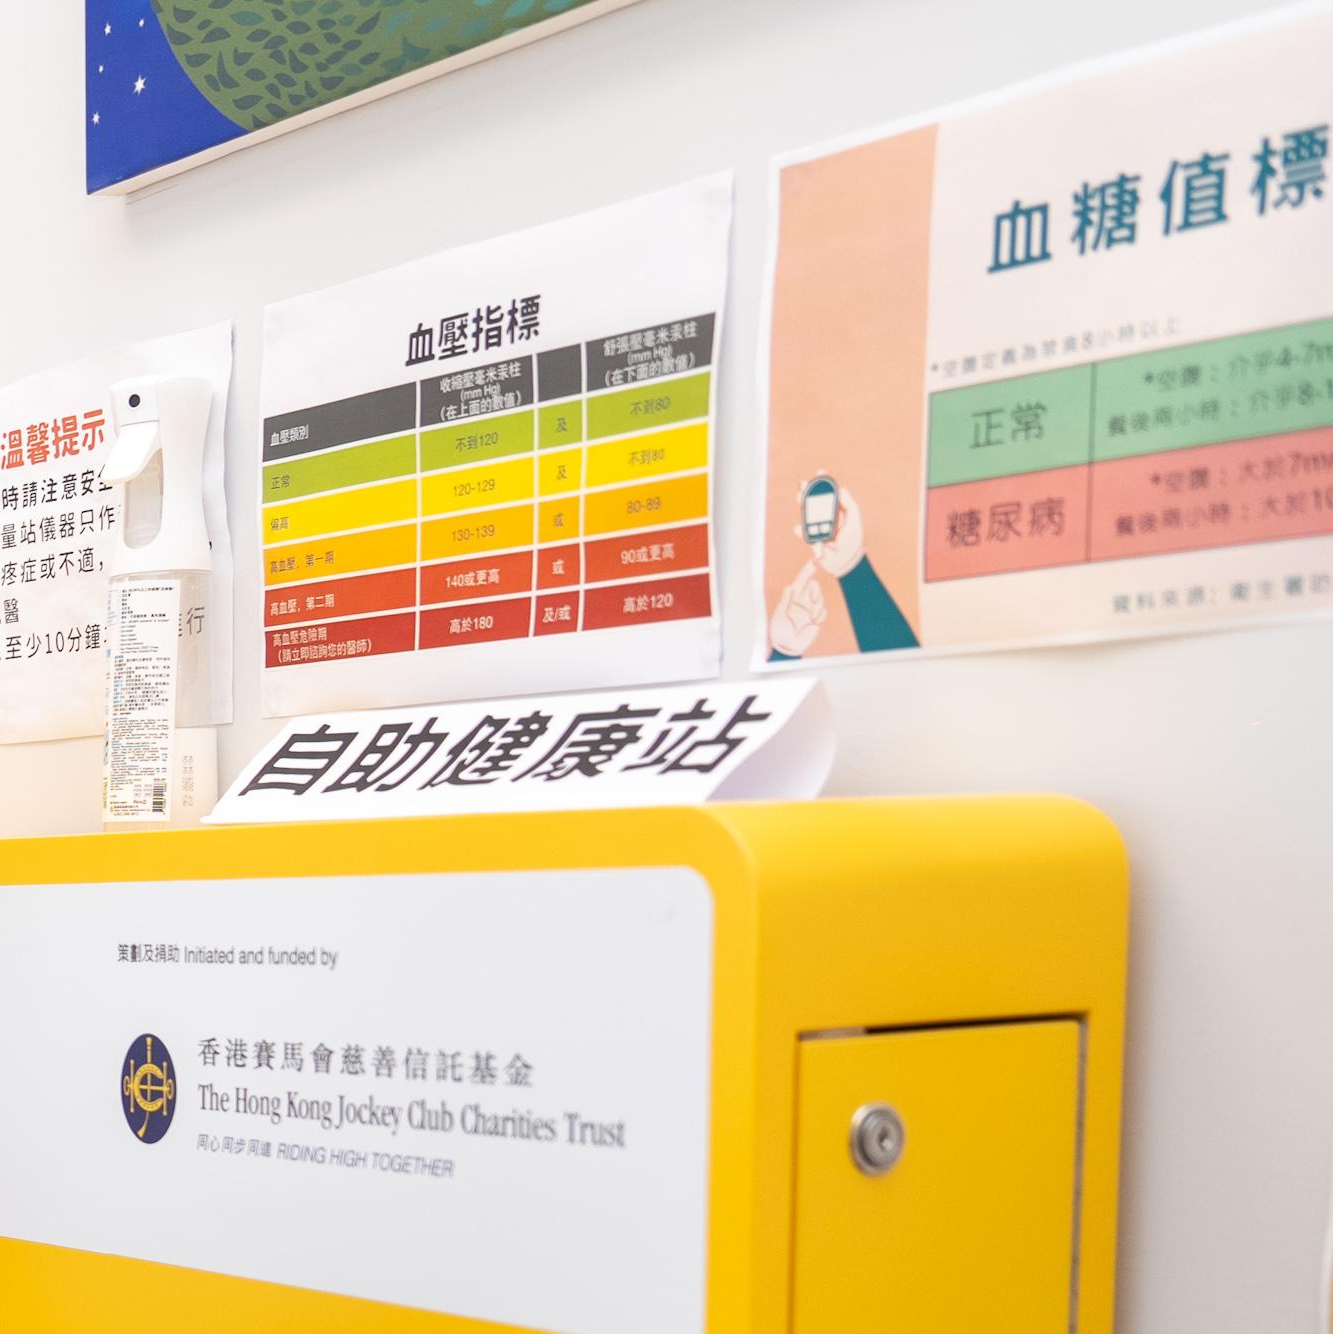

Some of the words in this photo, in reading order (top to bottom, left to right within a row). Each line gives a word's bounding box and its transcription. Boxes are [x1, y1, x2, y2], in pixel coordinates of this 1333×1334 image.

[405, 294, 541, 366] 血壓指標
[556, 417, 568, 432] 及
[969, 400, 1047, 449] 正常
[0, 408, 106, 470] 溫馨提示
[270, 424, 309, 447] 血壓類別
[455, 432, 499, 452] 不到120
[271, 474, 291, 490] 正常
[556, 465, 567, 481] 及
[453, 478, 496, 497] 120-129
[627, 497, 662, 515] 80-89
[553, 513, 564, 528] 或
[946, 496, 1066, 548] 糖尿病
[452, 524, 495, 543] 130-139
[621, 542, 676, 565] 90或更高
[552, 560, 565, 575] 或
[445, 568, 500, 588] 140或更高
[623, 593, 673, 614] 高於120
[542, 604, 572, 624] 及/或
[449, 615, 493, 635] 高於180
[238, 694, 773, 797] 自助健康站
[117, 943, 180, 963] 策劃及捐助
[184, 946, 234, 964] Initiated
[238, 947, 264, 965] and
[268, 946, 317, 966] funded
[320, 948, 339, 970] by
[196, 1036, 534, 1088] 香港賽馬會慈善信託基金
[197, 1083, 230, 1112] The
[234, 1086, 281, 1126] Hong
[286, 1089, 333, 1128] Kong
[335, 1093, 403, 1136] Jockey
[407, 1097, 455, 1134] Club
[460, 1102, 557, 1143] Charities
[563, 1111, 627, 1149] Trust
[277, 1143, 326, 1165] RIDING
[329, 1148, 366, 1169] HIGH
[371, 1151, 455, 1178] TOGETHER
